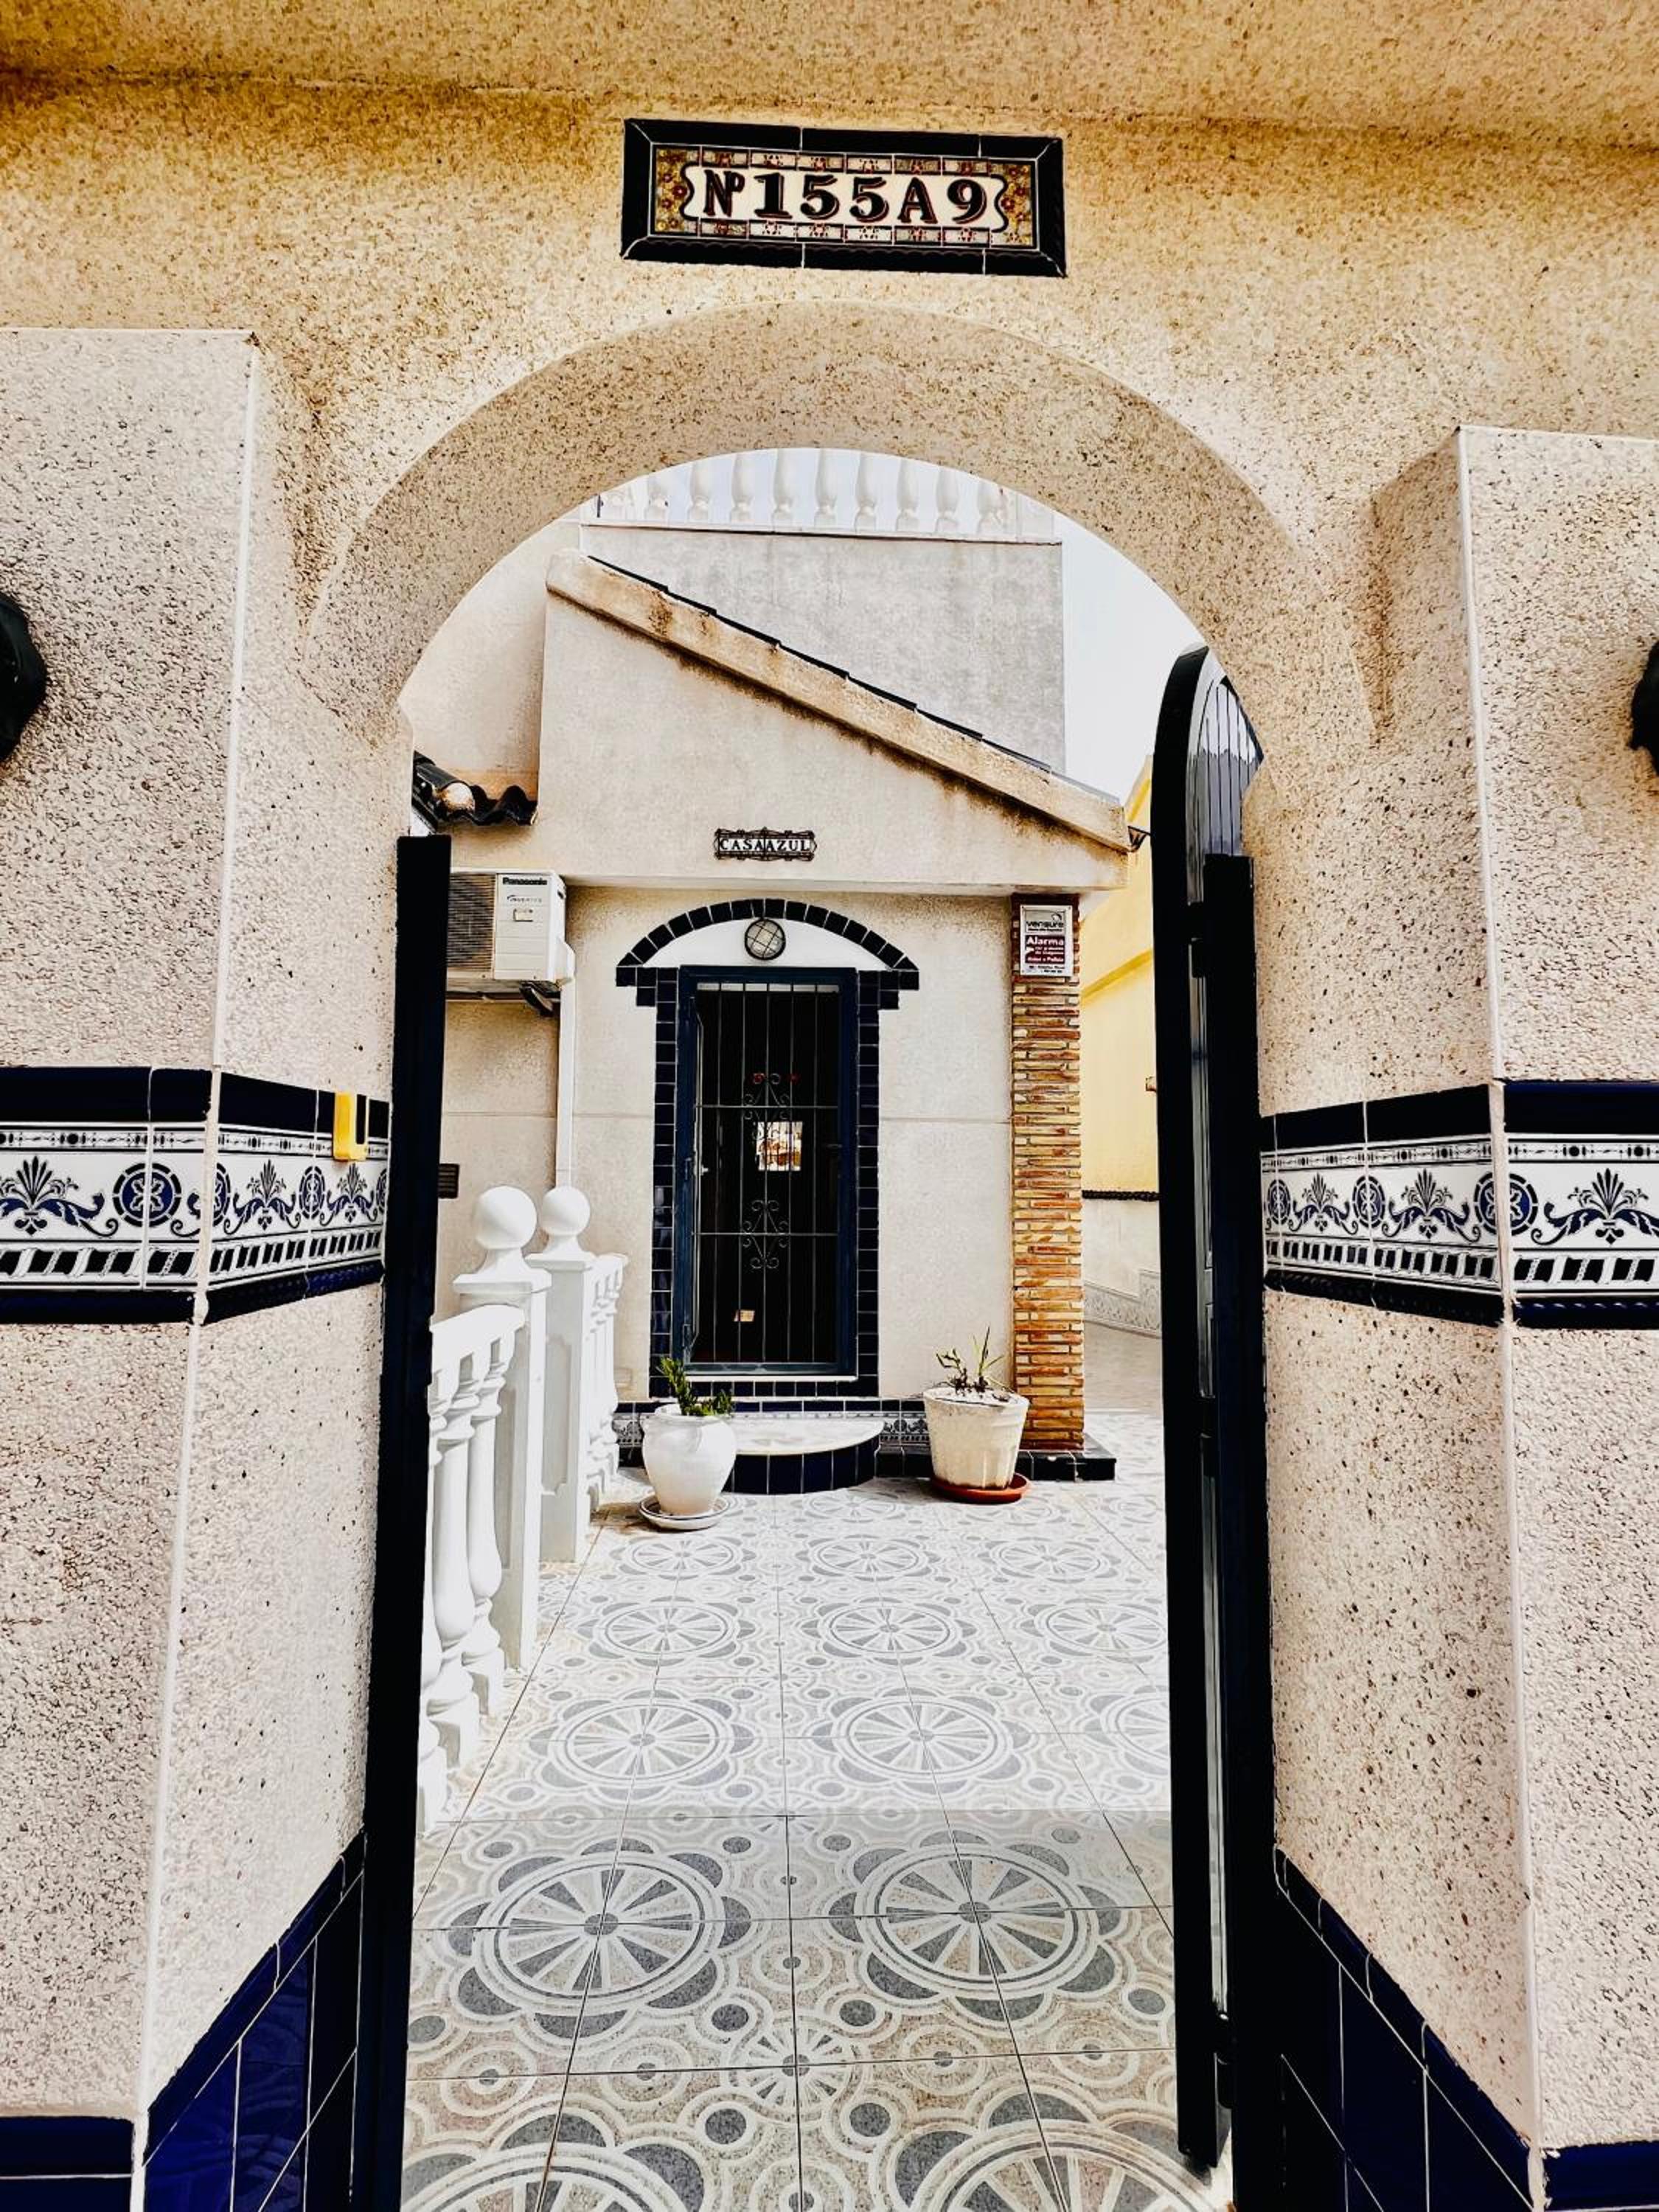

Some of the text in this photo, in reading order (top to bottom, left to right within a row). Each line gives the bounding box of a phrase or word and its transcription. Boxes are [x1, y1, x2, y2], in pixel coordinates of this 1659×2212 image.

[720, 838, 810, 852] CASA AZUL
[1026, 936, 1064, 946] Alarma
